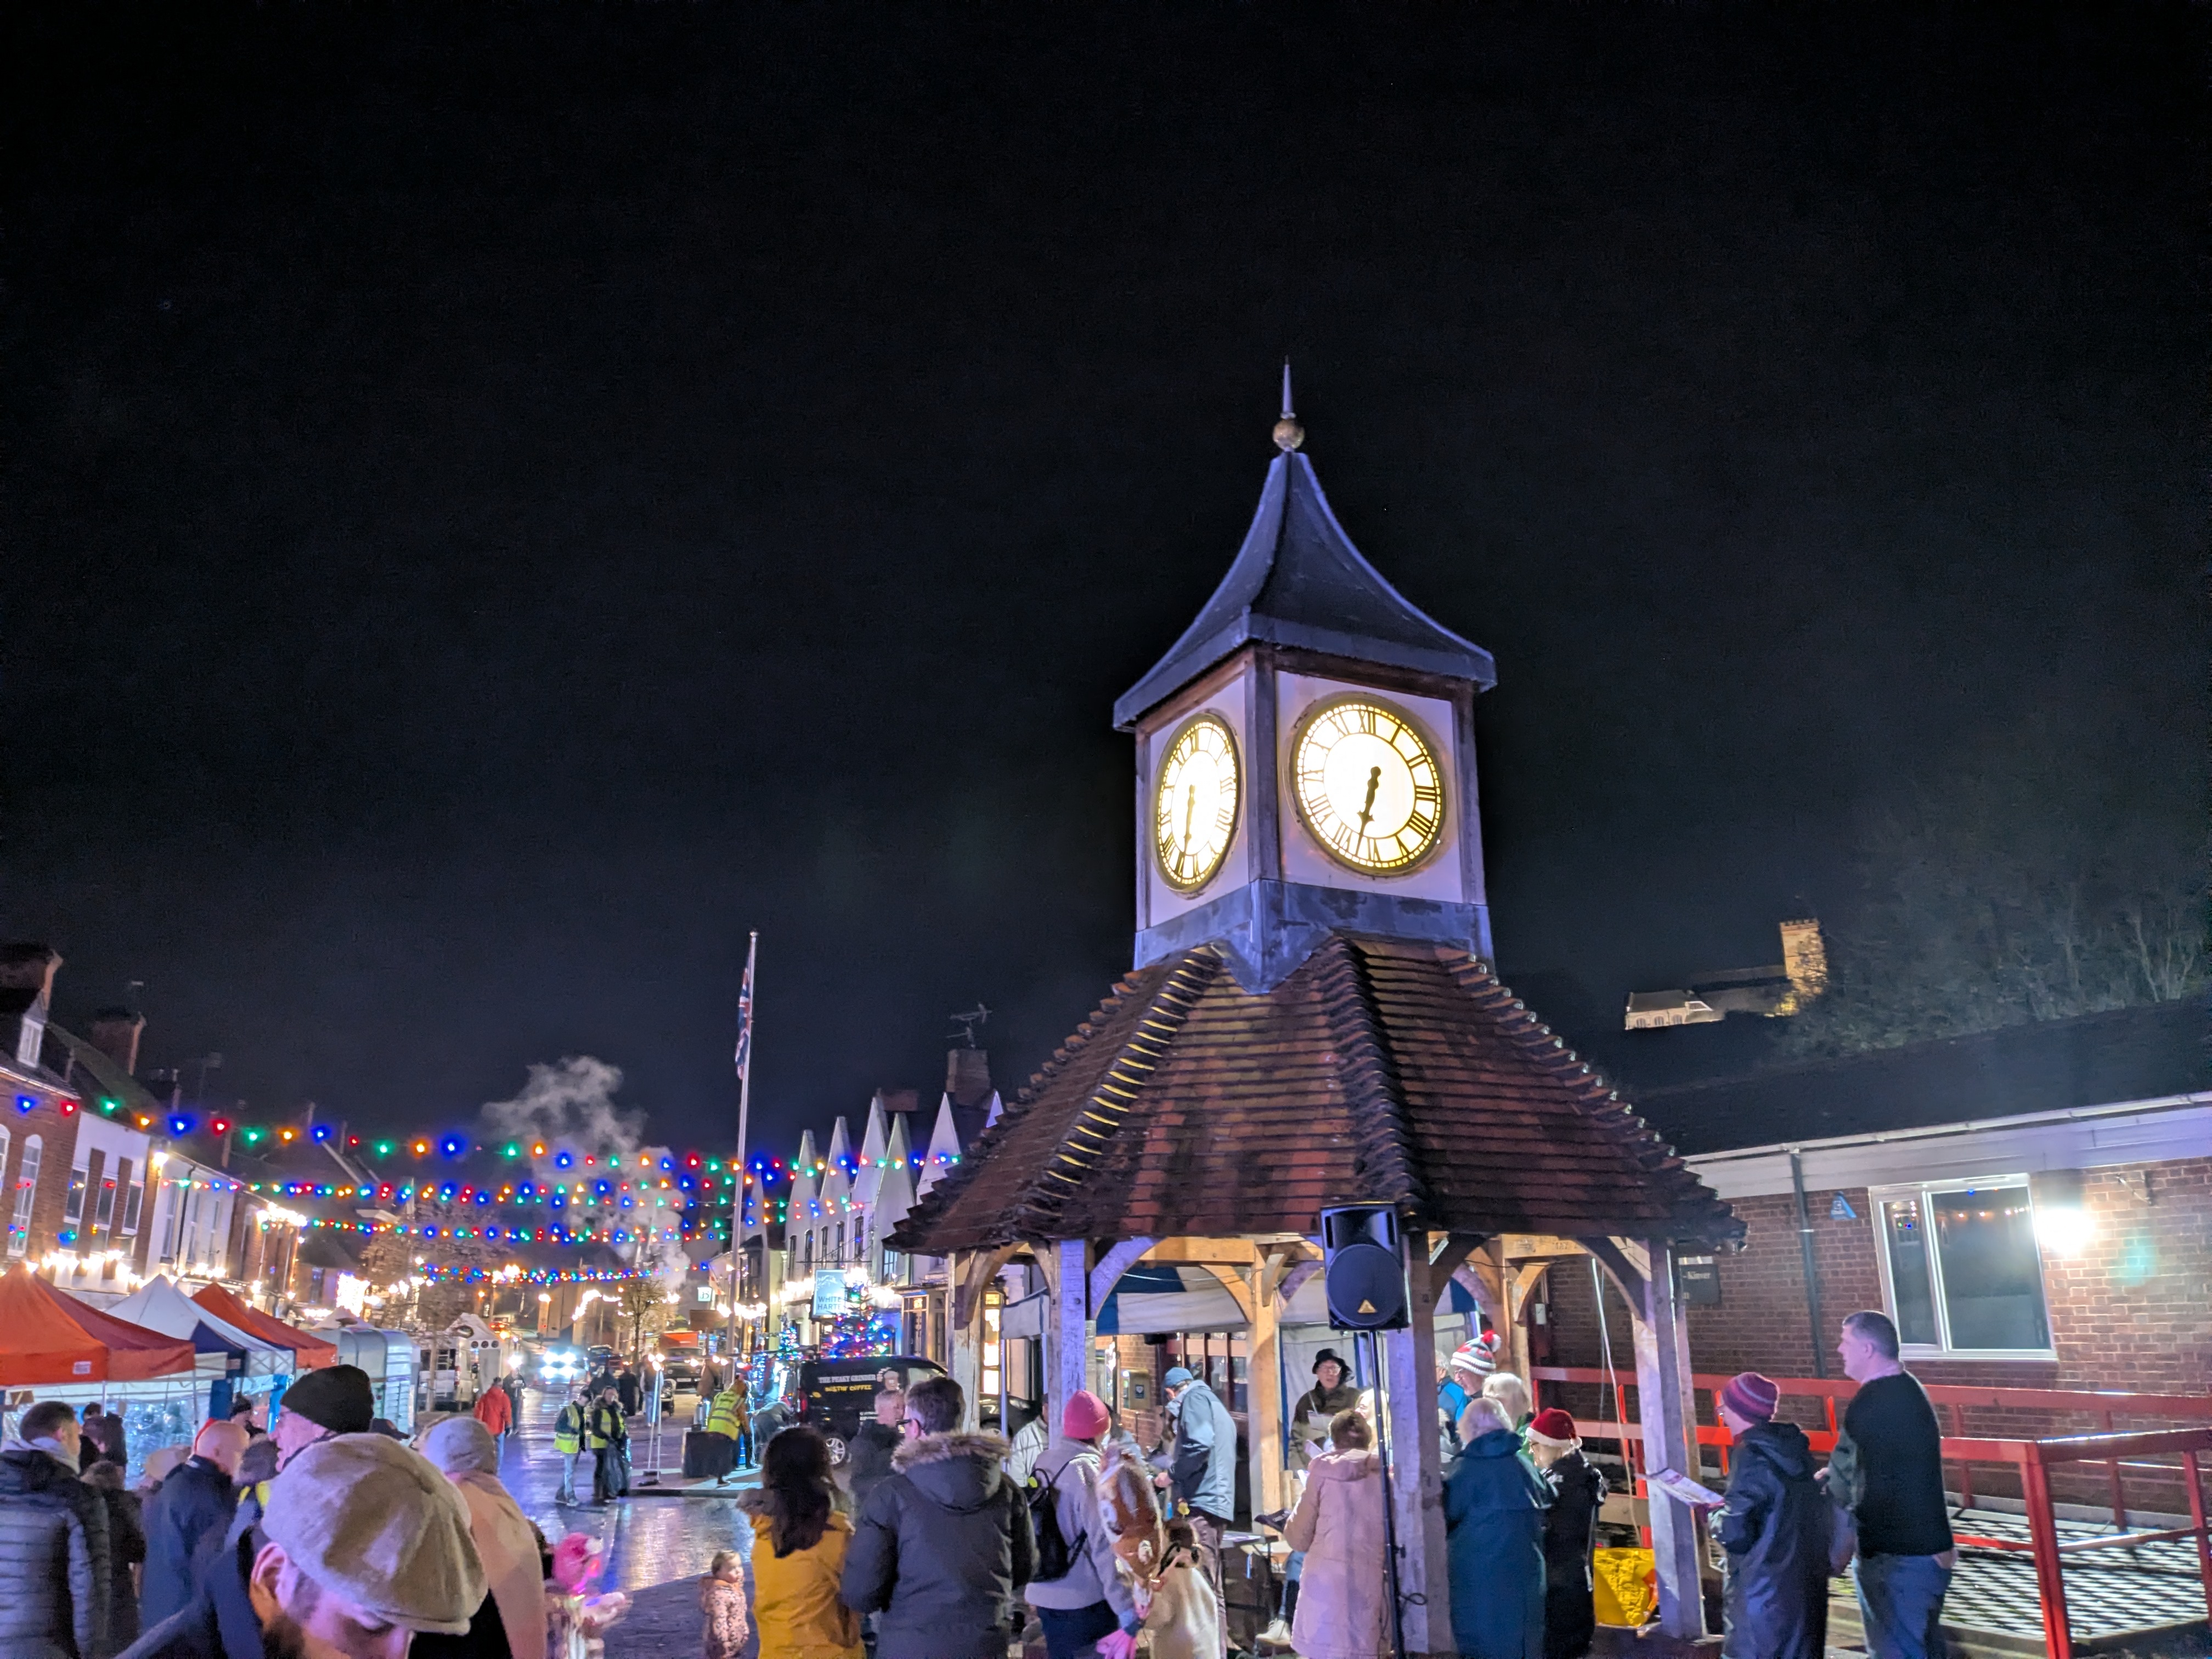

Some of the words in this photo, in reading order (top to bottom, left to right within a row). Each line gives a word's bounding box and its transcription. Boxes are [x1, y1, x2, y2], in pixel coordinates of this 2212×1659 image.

[1359, 710, 1376, 735] XII
[1406, 754, 1426, 769] II
[1415, 785, 1436, 803] III
[1408, 811, 1434, 839] IIII
